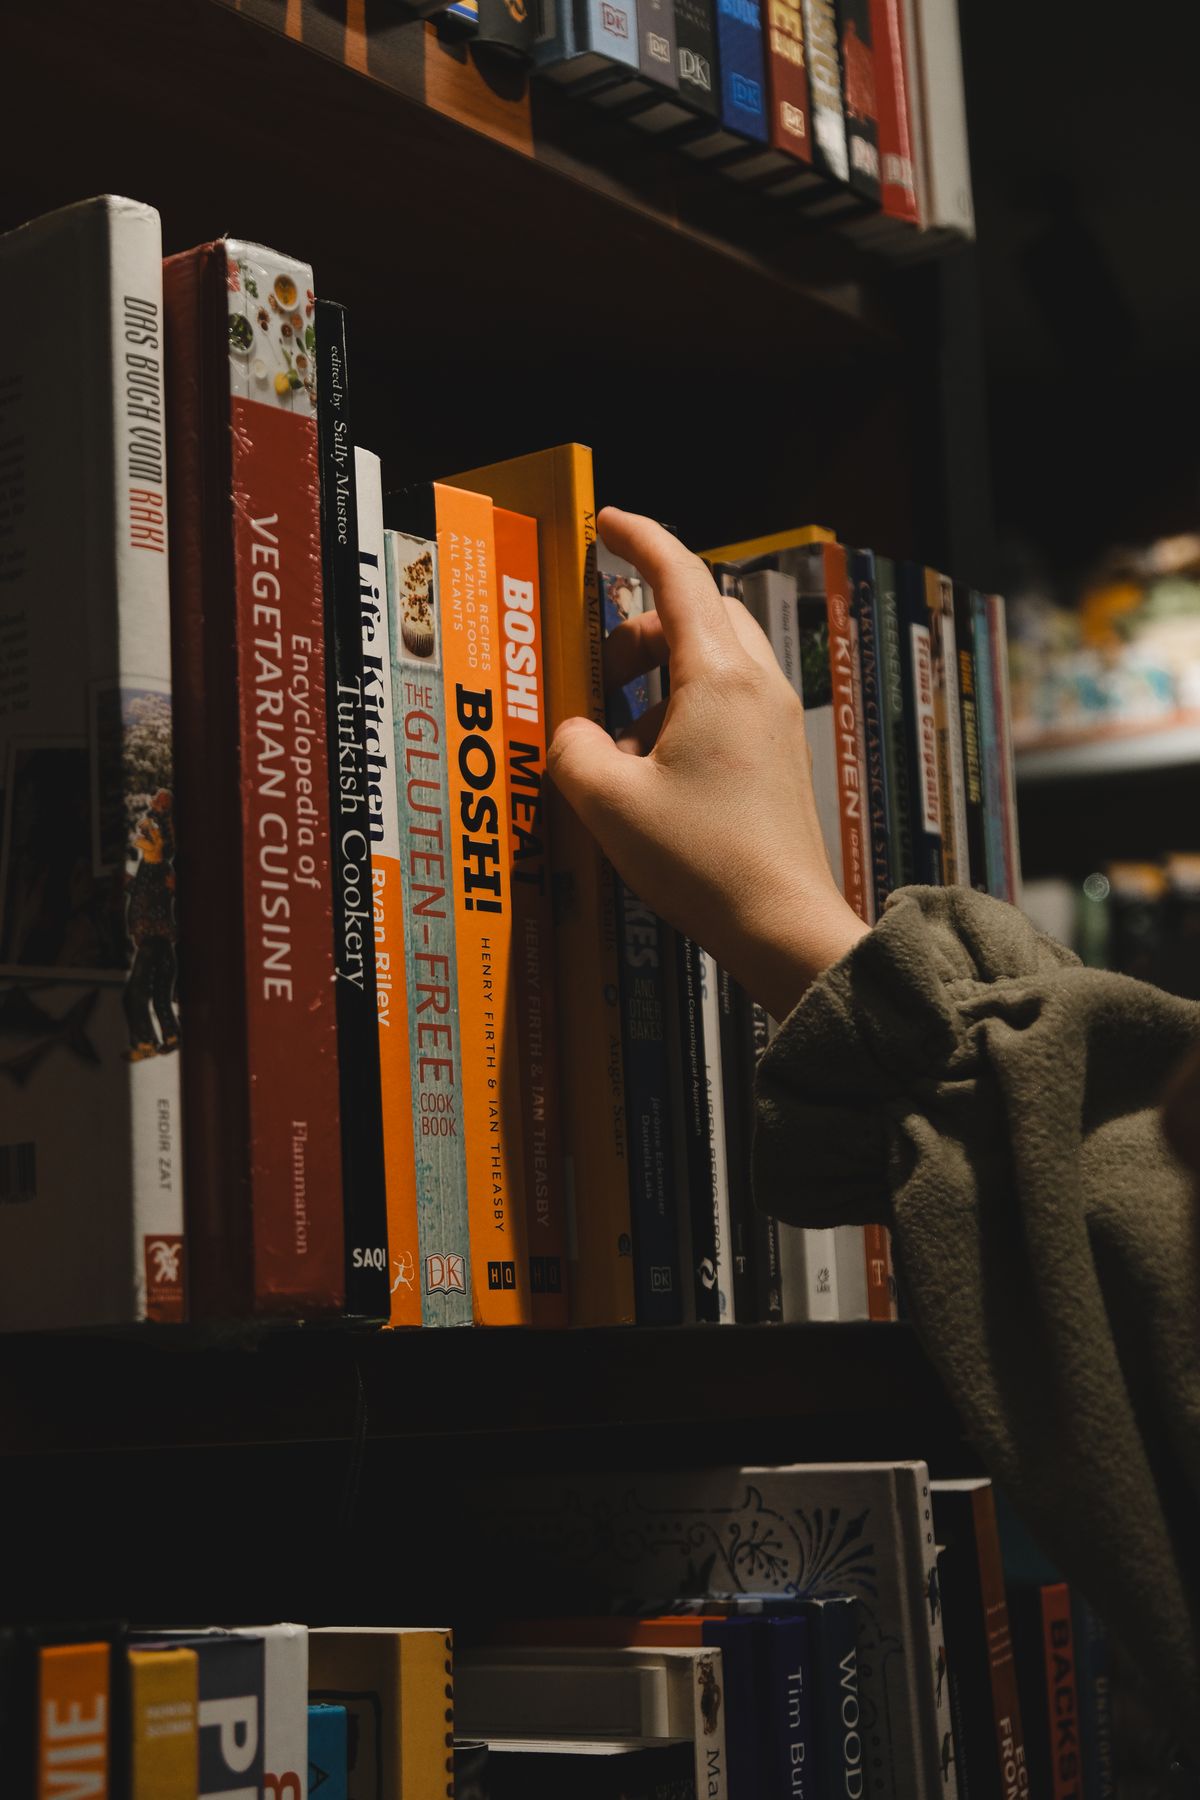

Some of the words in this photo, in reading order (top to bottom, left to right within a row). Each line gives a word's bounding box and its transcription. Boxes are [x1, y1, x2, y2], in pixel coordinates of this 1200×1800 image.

[683, 49, 709, 85] DK
[124, 295, 159, 350] DAS
[125, 353, 162, 424] BUCH
[331, 345, 344, 389] edited
[330, 391, 344, 411] by
[128, 426, 163, 485] VOM
[331, 419, 349, 467] Sally
[129, 488, 165, 554] RAKI
[335, 470, 352, 546] Mustoe
[450, 532, 461, 559] ALL
[462, 535, 476, 611] AMAZING
[476, 539, 489, 595] SIMPLE
[360, 552, 382, 643] Life
[452, 563, 463, 631] PLANTS
[250, 512, 286, 801] VEGETARIAN
[467, 616, 478, 669] FOOD
[479, 599, 492, 672] RECIPES
[502, 574, 539, 724] BOSH!
[885, 591, 904, 712] WEEKEND
[405, 682, 433, 708] THE
[917, 636, 932, 705] Frame
[290, 633, 320, 848] Encyclopedia
[336, 676, 363, 815] Turkish
[360, 650, 388, 845] Kitchen
[836, 636, 862, 819] KITCHEN
[850, 826, 863, 886] IDEAS
[922, 714, 940, 825] Carpentry
[455, 682, 502, 915] BOSH!
[508, 740, 545, 896] MEAT
[258, 812, 293, 1001] CUISINE
[294, 859, 321, 890] of
[370, 868, 386, 947] Ryan
[404, 710, 455, 1086] GLUTEN-FREE
[335, 829, 365, 993] Cookery
[480, 936, 494, 1003] HENRY
[524, 917, 541, 992] HENRY
[686, 975, 696, 997] and
[374, 952, 391, 1028] Riley
[484, 1011, 496, 1071] FIRTH
[529, 995, 544, 1061] FIRTH
[687, 999, 701, 1078] Cosmological
[419, 1091, 454, 1114] COOK
[487, 1078, 497, 1089] &
[531, 1062, 544, 1080] &
[533, 1085, 546, 1121] IAN
[422, 1115, 457, 1138] BOOK
[488, 1100, 499, 1134] IAN
[612, 1104, 626, 1160] Scarr
[690, 1080, 703, 1137] Approach
[159, 1156, 173, 1192] ZAT
[292, 1120, 309, 1255] Flammarion
[490, 1143, 506, 1233] THEASBY
[534, 1127, 551, 1228] THEASBY
[352, 1247, 387, 1268] SAQI
[427, 1256, 466, 1289] DK
[787, 1665, 803, 1729] Tim
[839, 1646, 863, 1800] WOOD
